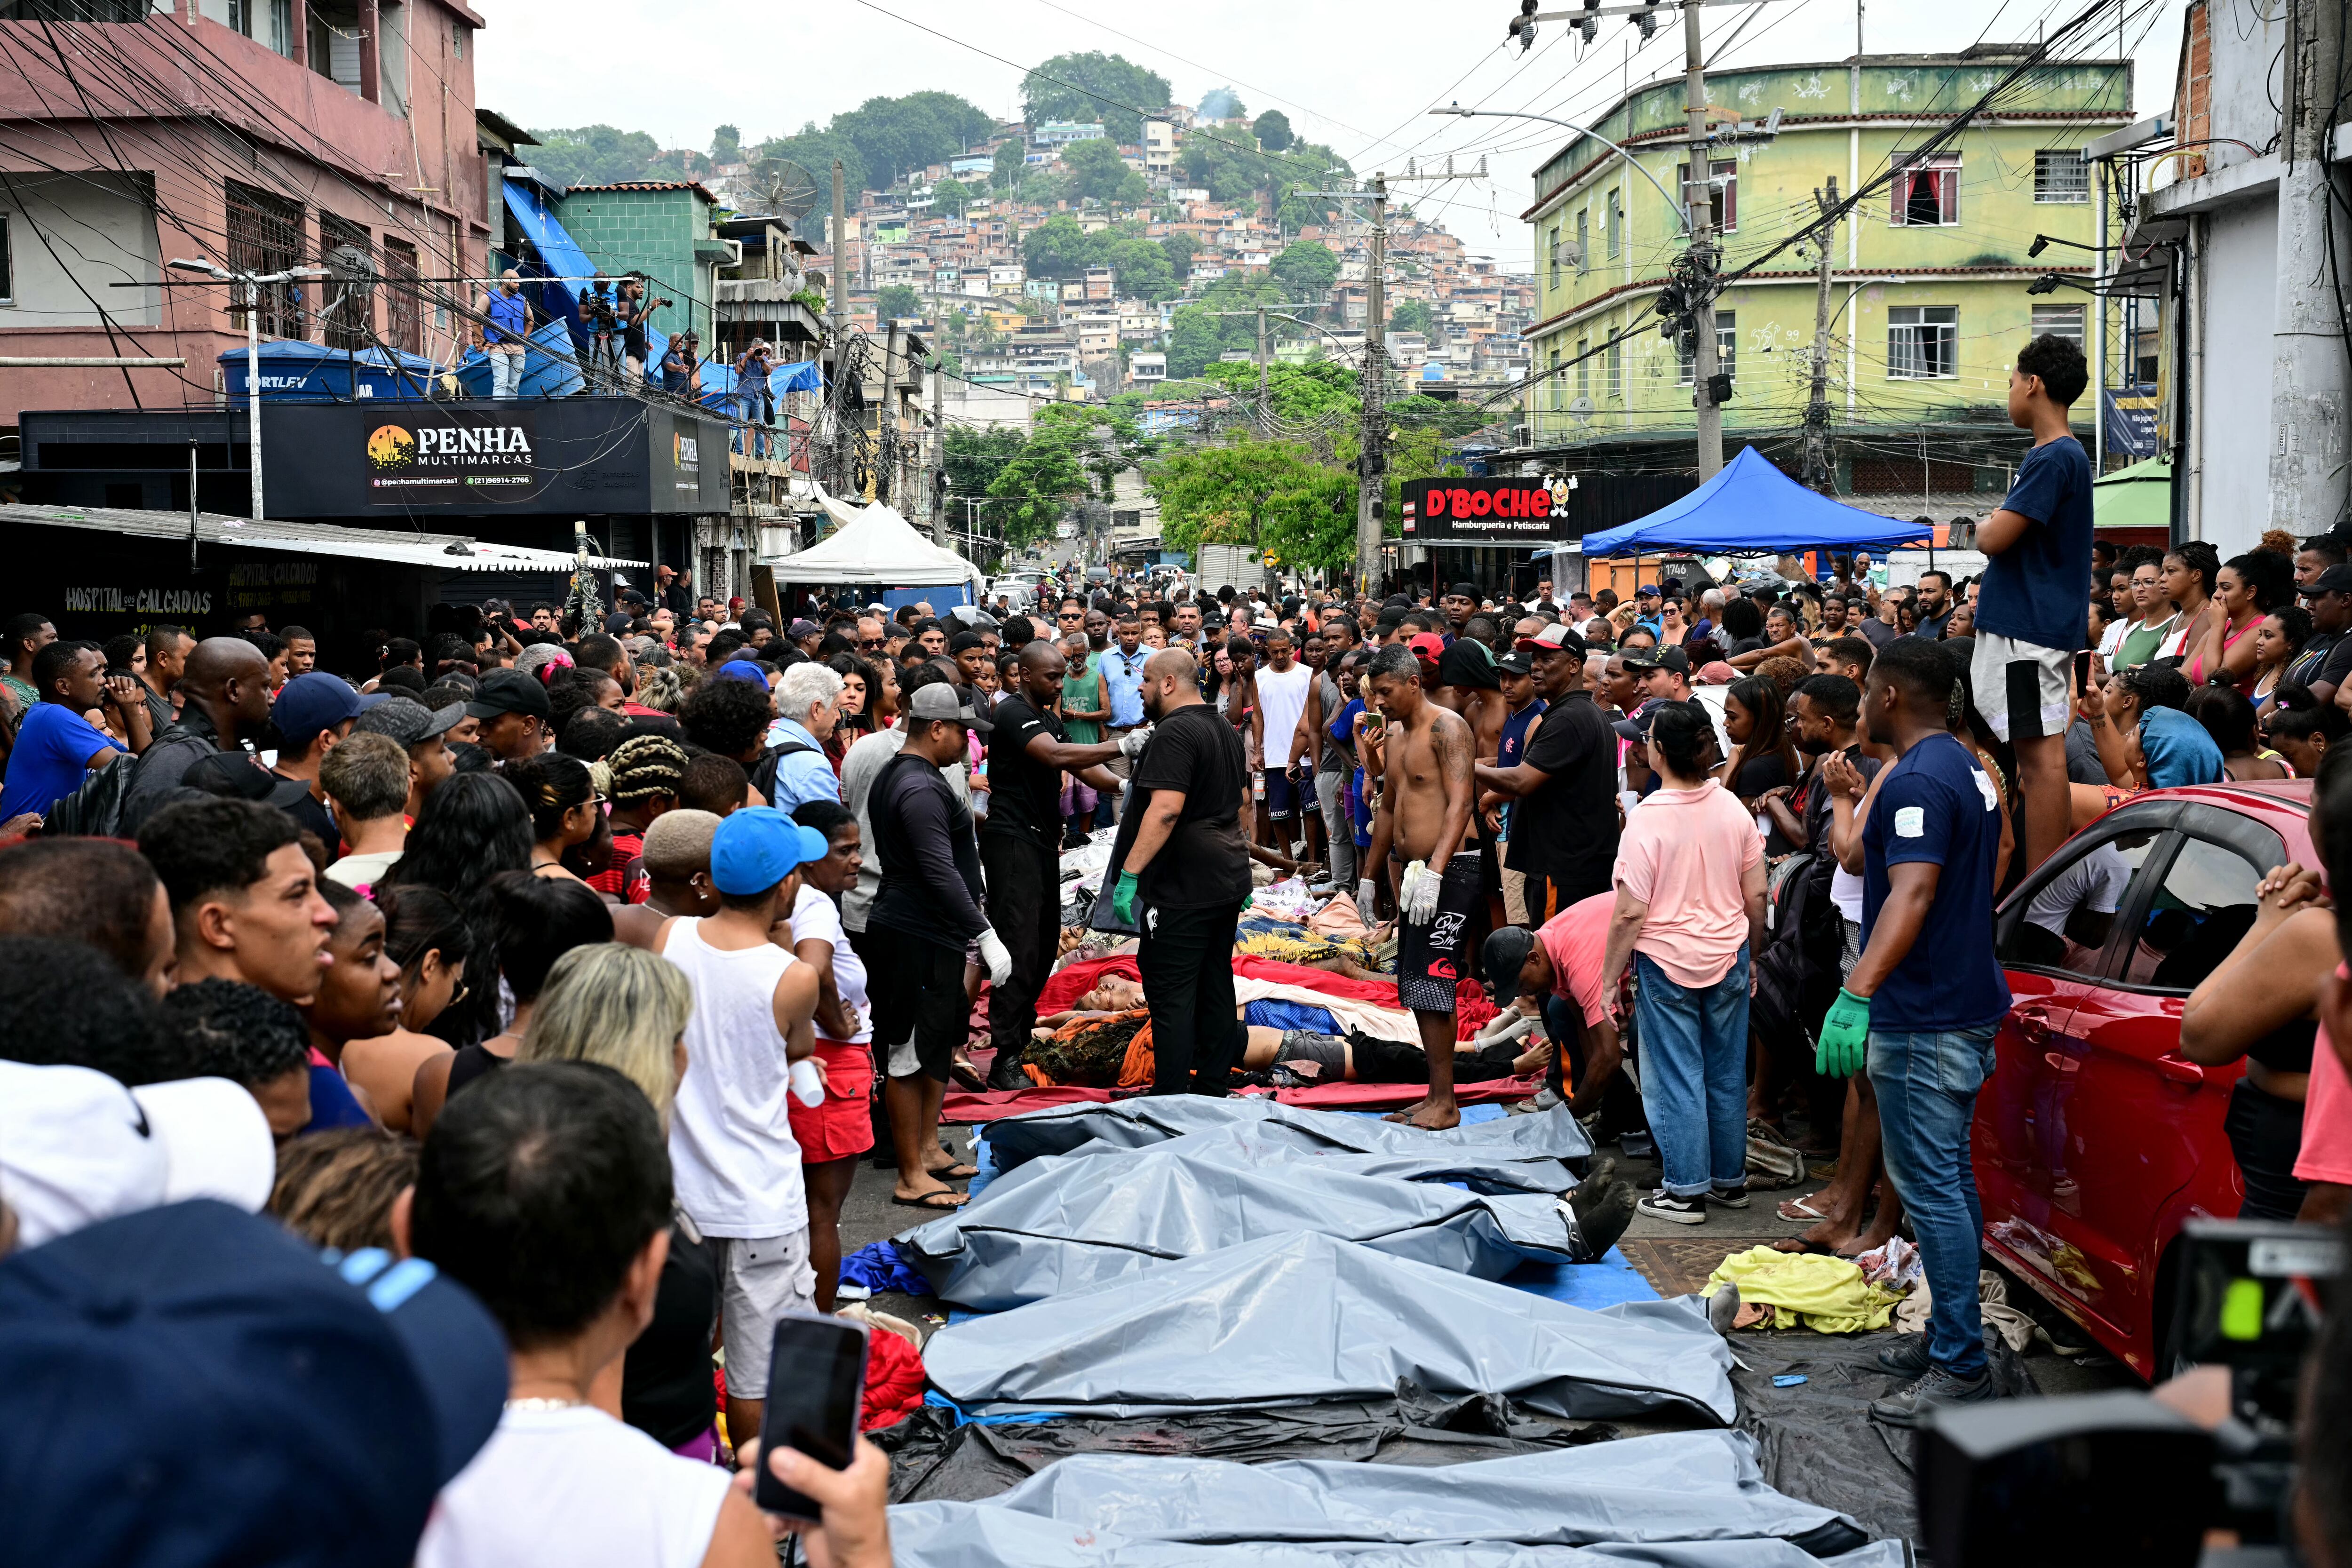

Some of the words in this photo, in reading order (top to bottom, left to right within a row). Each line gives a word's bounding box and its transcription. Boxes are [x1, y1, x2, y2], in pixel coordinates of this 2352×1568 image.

[2140, 414, 2152, 423] jogue
[417, 427, 531, 454] PENHA
[680, 437, 698, 462] PENHA
[419, 454, 532, 466] MULTIMARCAS
[681, 462, 699, 472] MULTIMARCAS
[381, 478, 458, 486] @penhamultimarcas1
[1452, 520, 1505, 531] Hamburgueria
[1514, 520, 1549, 530] Petiscaria
[1666, 564, 1686, 575] 1746
[65, 587, 127, 612] HOSPITAL
[136, 589, 212, 614] CALCADOS
